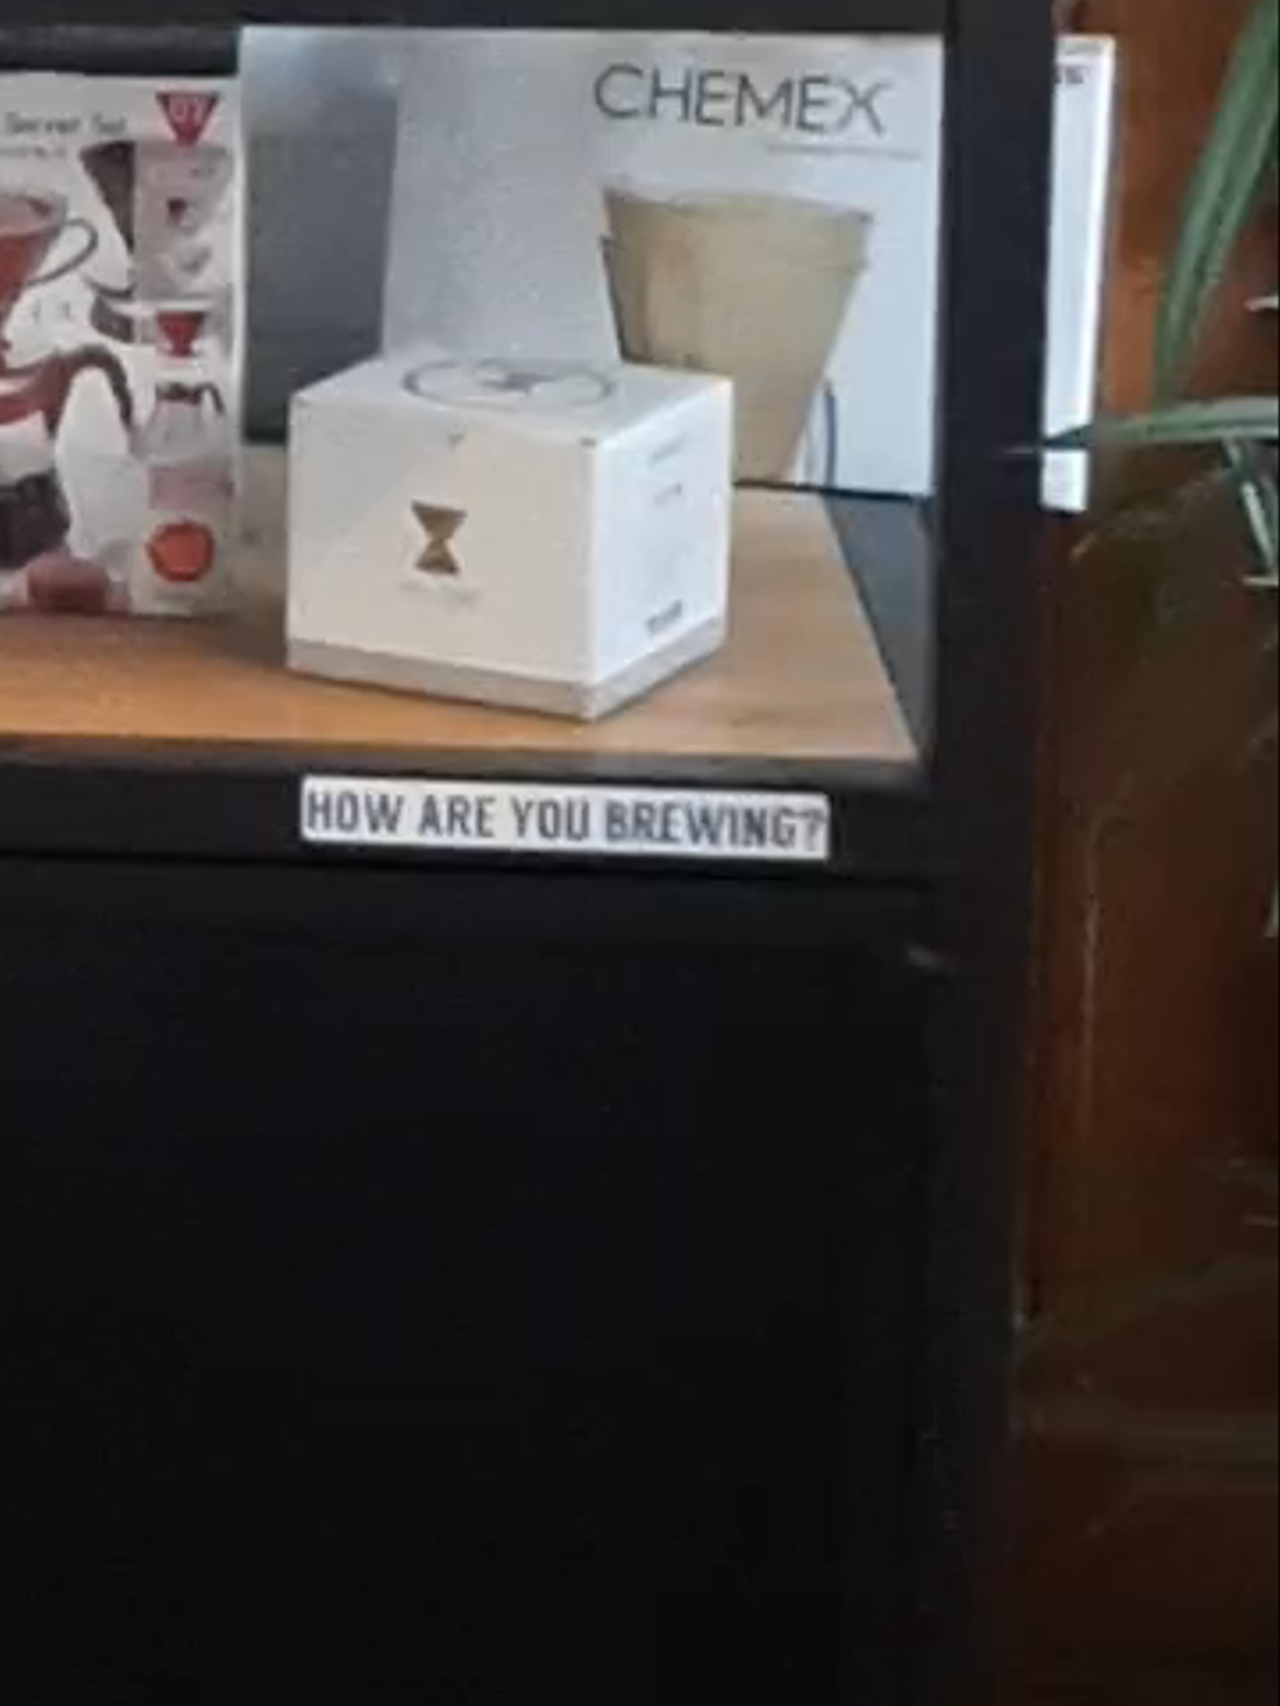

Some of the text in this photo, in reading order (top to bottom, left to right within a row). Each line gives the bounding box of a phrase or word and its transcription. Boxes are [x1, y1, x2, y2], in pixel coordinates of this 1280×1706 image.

[592, 63, 887, 137] CHEMEX
[306, 791, 827, 850] HOW ARE YOU BREWING?
